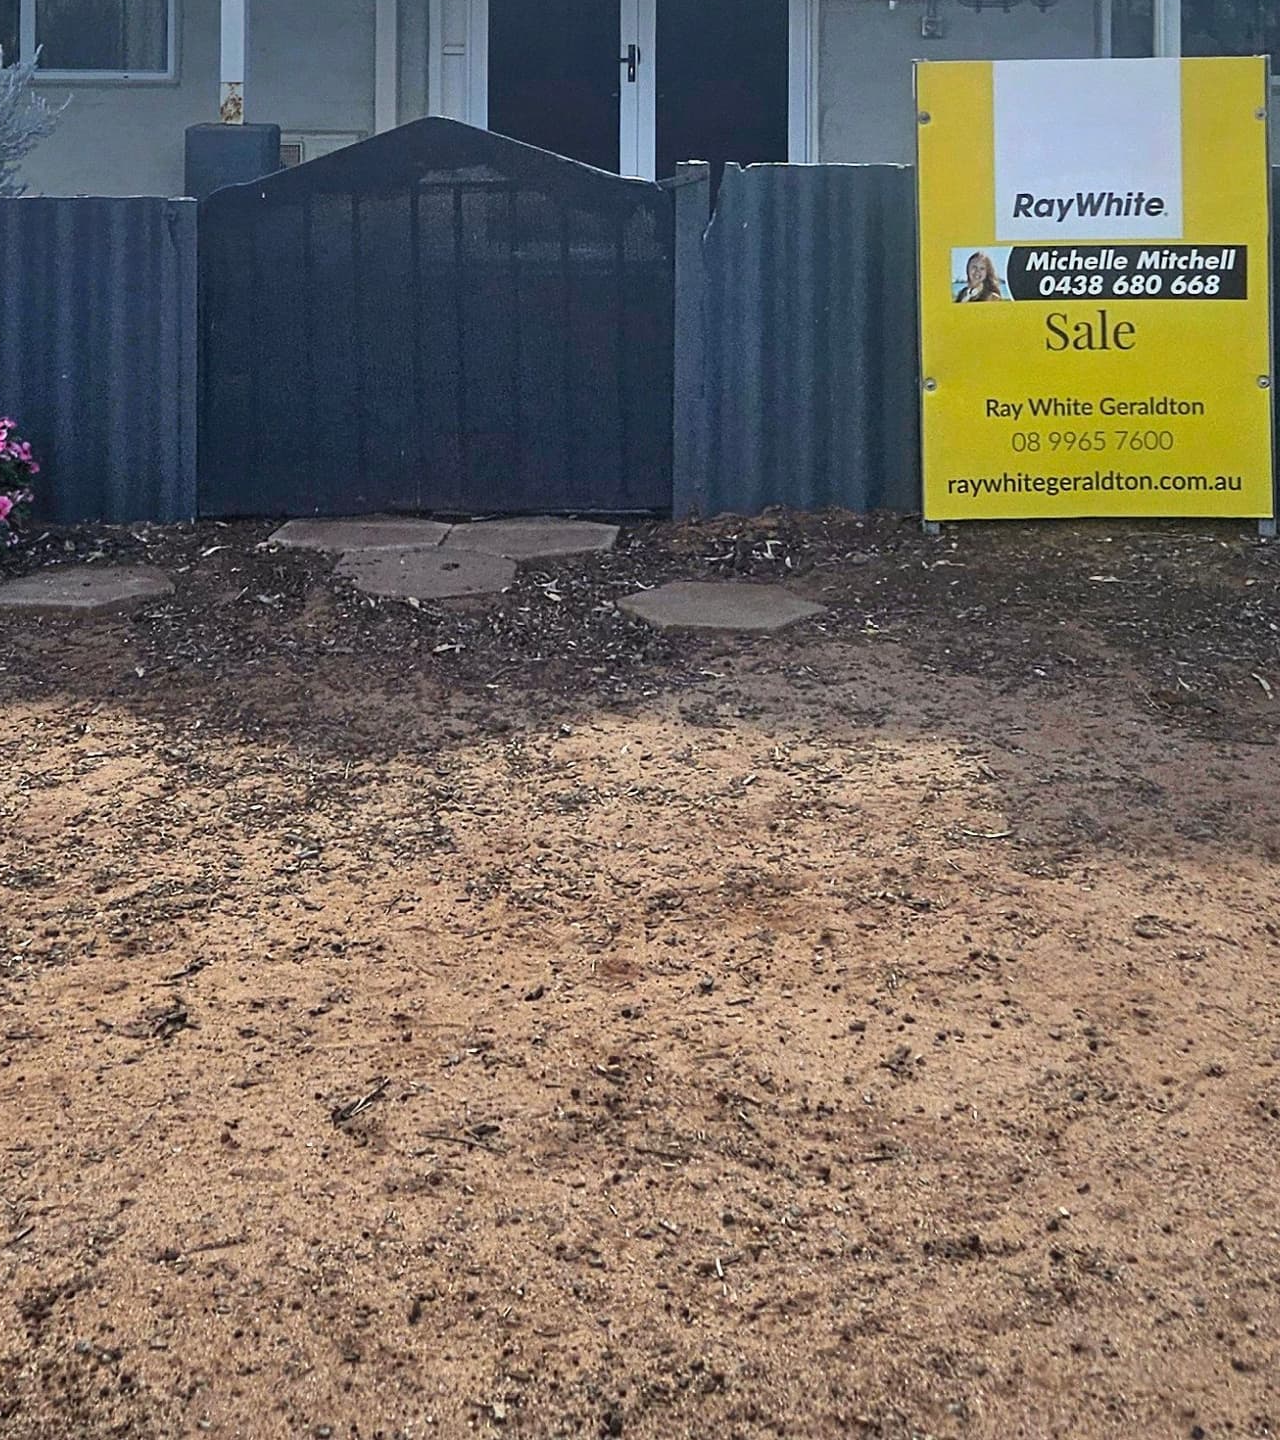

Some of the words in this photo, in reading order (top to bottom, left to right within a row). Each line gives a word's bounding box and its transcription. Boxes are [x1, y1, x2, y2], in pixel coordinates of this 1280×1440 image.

[1025, 250, 1128, 272] Michelle
[1136, 249, 1236, 271] Mitchell
[1039, 275, 1103, 295] 0438
[1112, 275, 1162, 295] 680
[1170, 274, 1220, 295] 668
[1045, 309, 1136, 351] Sale
[986, 399, 1023, 420] Ray
[1028, 397, 1093, 416] White
[1099, 396, 1205, 416] Geraldton
[1011, 432, 1041, 452] 08
[1048, 431, 1106, 451] 9965
[1115, 430, 1174, 450] 7600
[948, 471, 1242, 497] raywhitegeraldton.com.au
